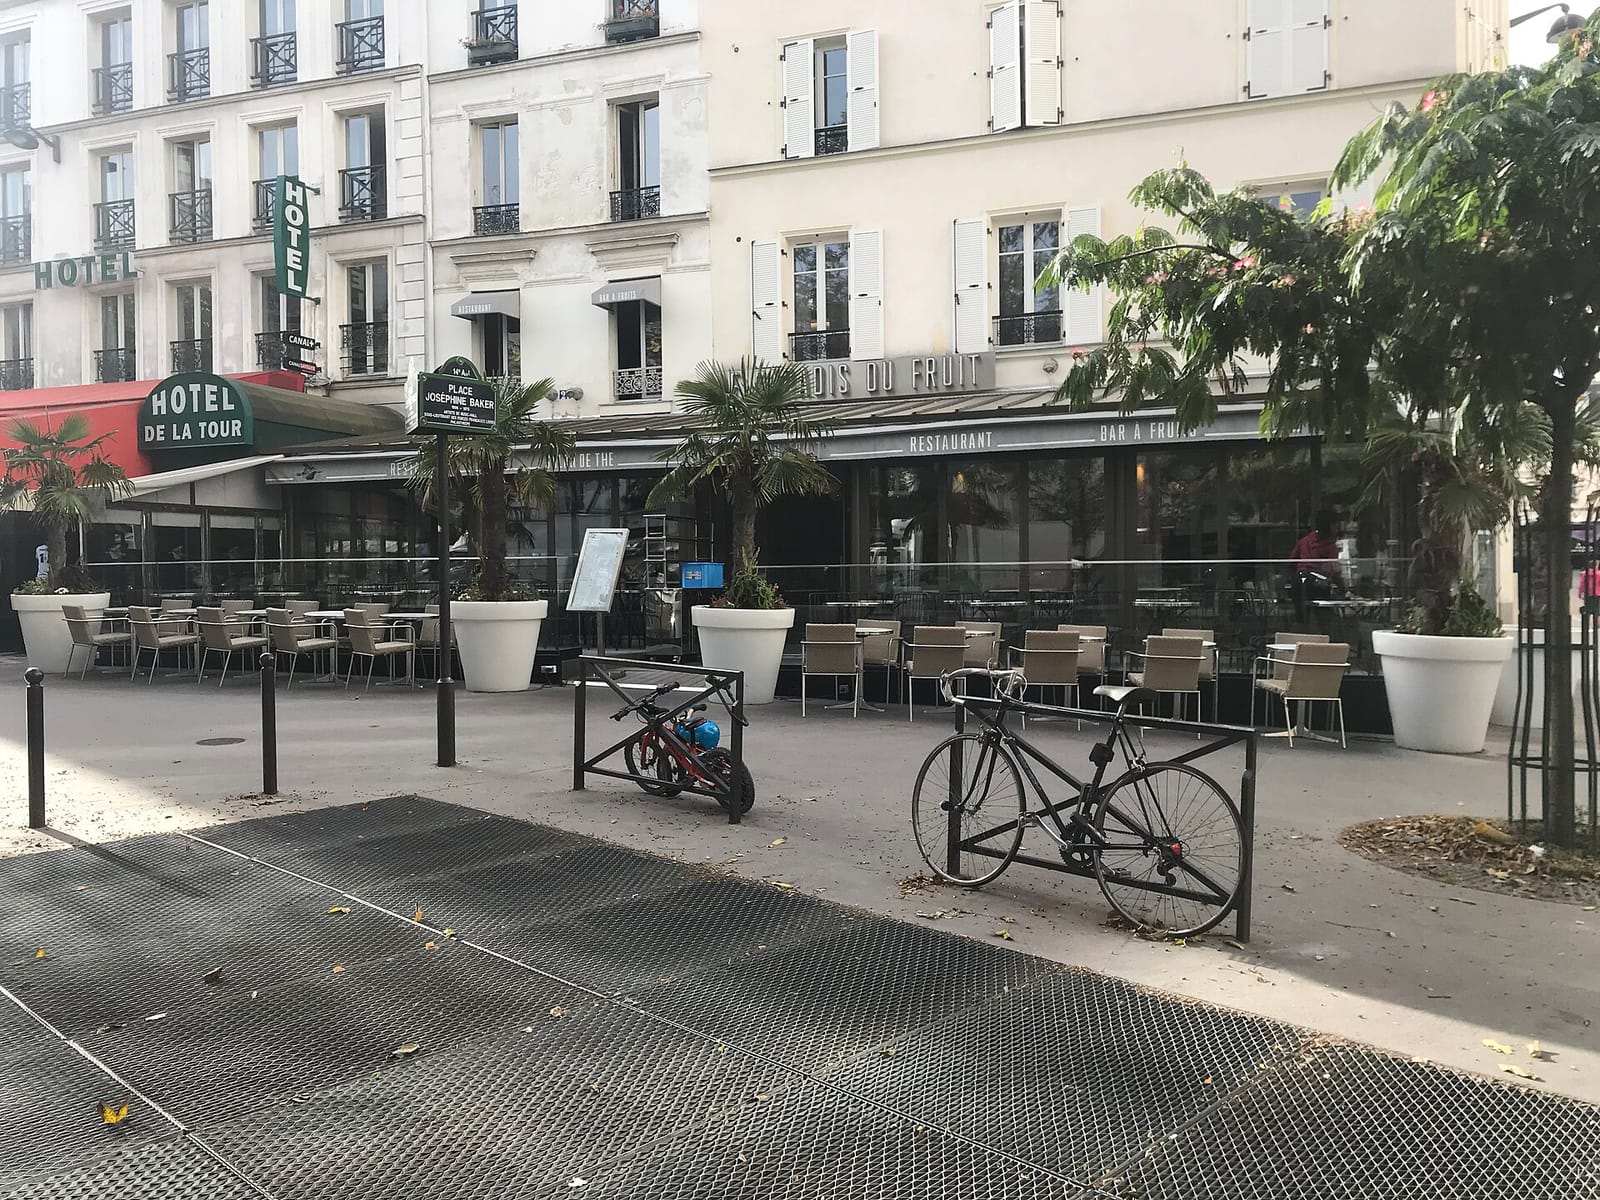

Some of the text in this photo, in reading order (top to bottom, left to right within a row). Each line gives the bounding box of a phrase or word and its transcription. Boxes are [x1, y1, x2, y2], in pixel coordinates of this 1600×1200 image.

[284, 180, 305, 292] HOTEL
[35, 252, 138, 289] HOTEL
[289, 335, 315, 348] CANAL+
[866, 360, 892, 392] DU
[911, 354, 980, 390] FRUIT
[152, 383, 235, 416] HOTEL
[425, 391, 495, 410] JOSÉPHINE BAKER
[448, 384, 473, 396] PLACE
[144, 419, 242, 442] DE LA TOUR
[1100, 424, 1126, 441] BAR
[910, 431, 992, 452] RESTAURANT
[580, 453, 591, 468] DE
